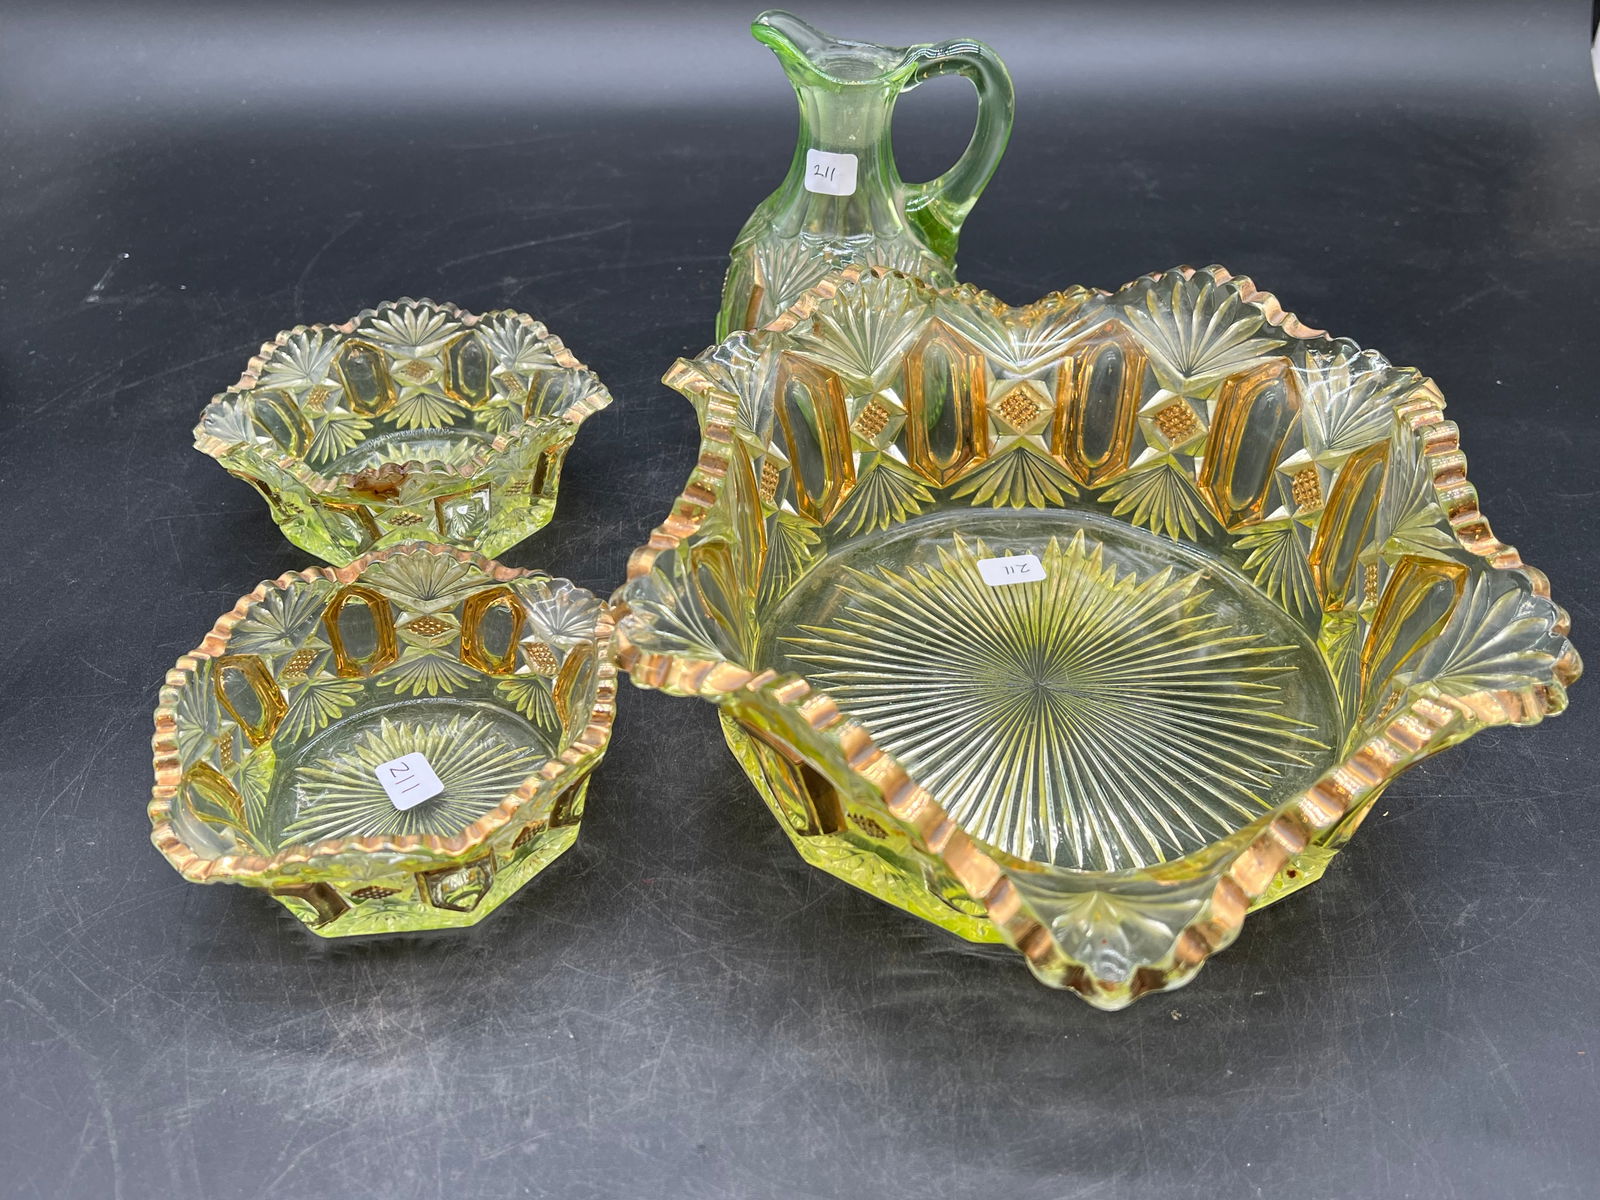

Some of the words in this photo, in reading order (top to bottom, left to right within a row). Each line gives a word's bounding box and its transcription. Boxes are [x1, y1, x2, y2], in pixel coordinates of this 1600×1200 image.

[814, 164, 836, 182] 211
[1004, 563, 1031, 576] 211
[389, 761, 420, 794] 211
